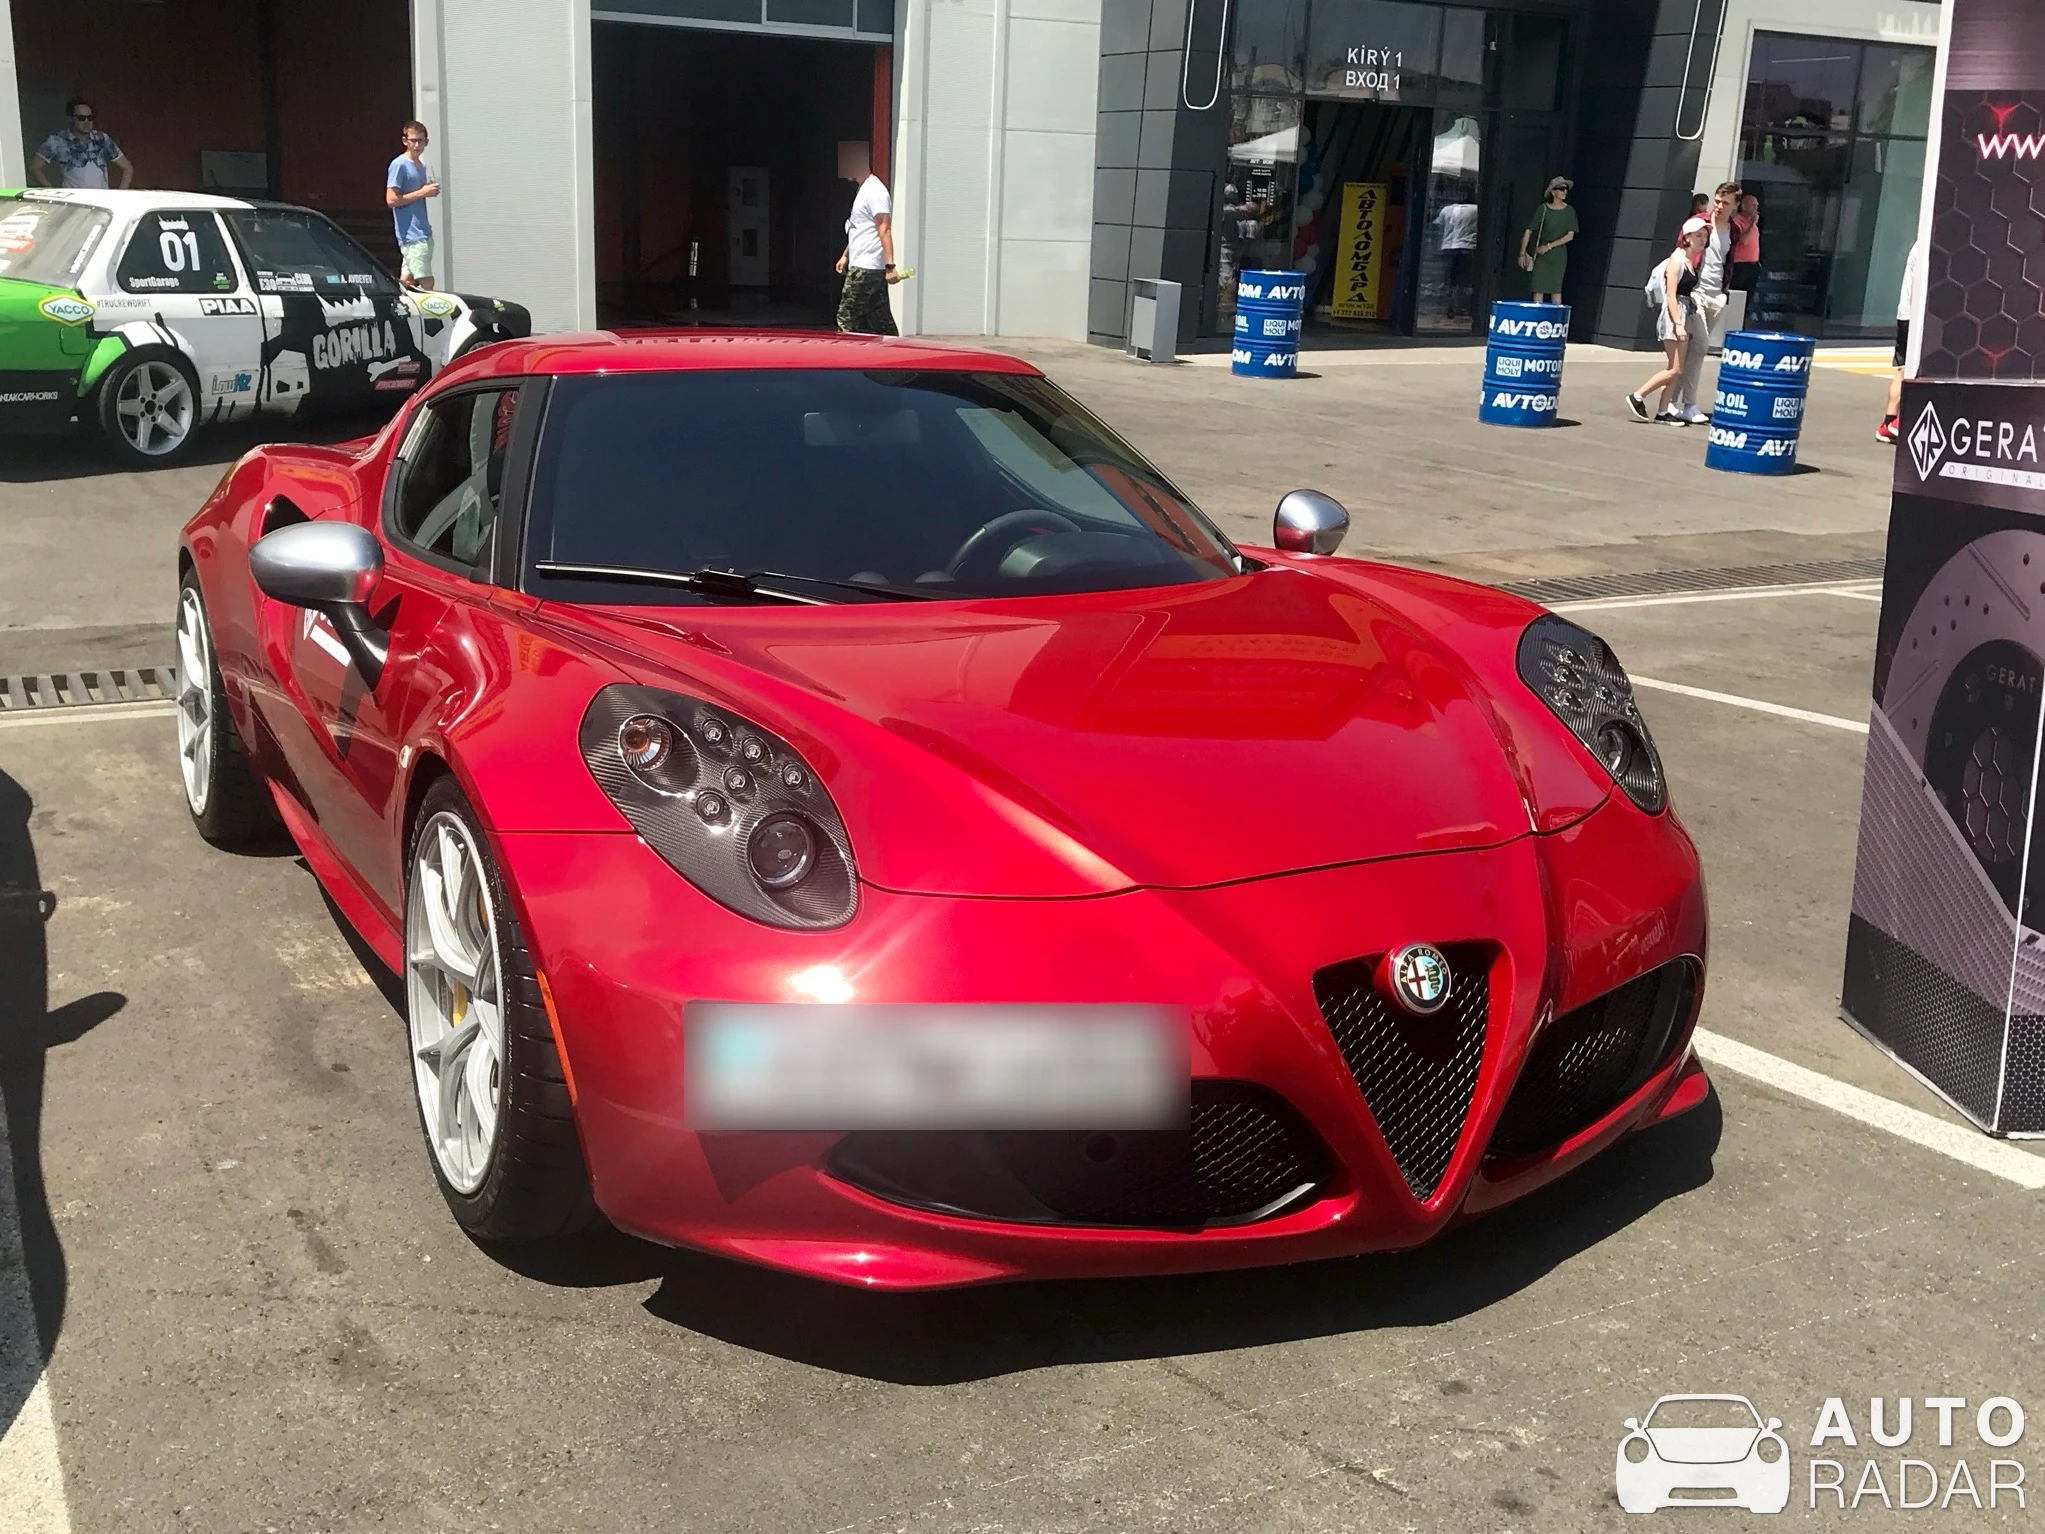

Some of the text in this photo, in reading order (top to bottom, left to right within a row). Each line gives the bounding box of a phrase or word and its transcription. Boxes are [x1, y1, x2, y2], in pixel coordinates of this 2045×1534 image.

[1395, 51, 1402, 67] 1
[1345, 70, 1400, 92] ВХОД 1
[159, 231, 201, 272] 01
[129, 276, 180, 289] SportGarage
[259, 278, 278, 291] E30
[49, 304, 90, 315] YACCO
[202, 299, 256, 315] PIAA
[424, 301, 450, 311] YACCO
[1265, 320, 1286, 328] LIQUI
[1264, 327, 1285, 335] MOLY
[312, 319, 397, 371] GORILLA
[1498, 358, 1521, 367] LIQUI
[1497, 366, 1520, 376] MOLY
[1726, 392, 1749, 410] OIL
[1776, 399, 1799, 408] LIQUI
[1724, 407, 1748, 418] Germany
[1775, 408, 1798, 418] MOLY
[1950, 417, 2045, 463] GERA
[1400, 947, 1448, 984] ALFA ROMEO
